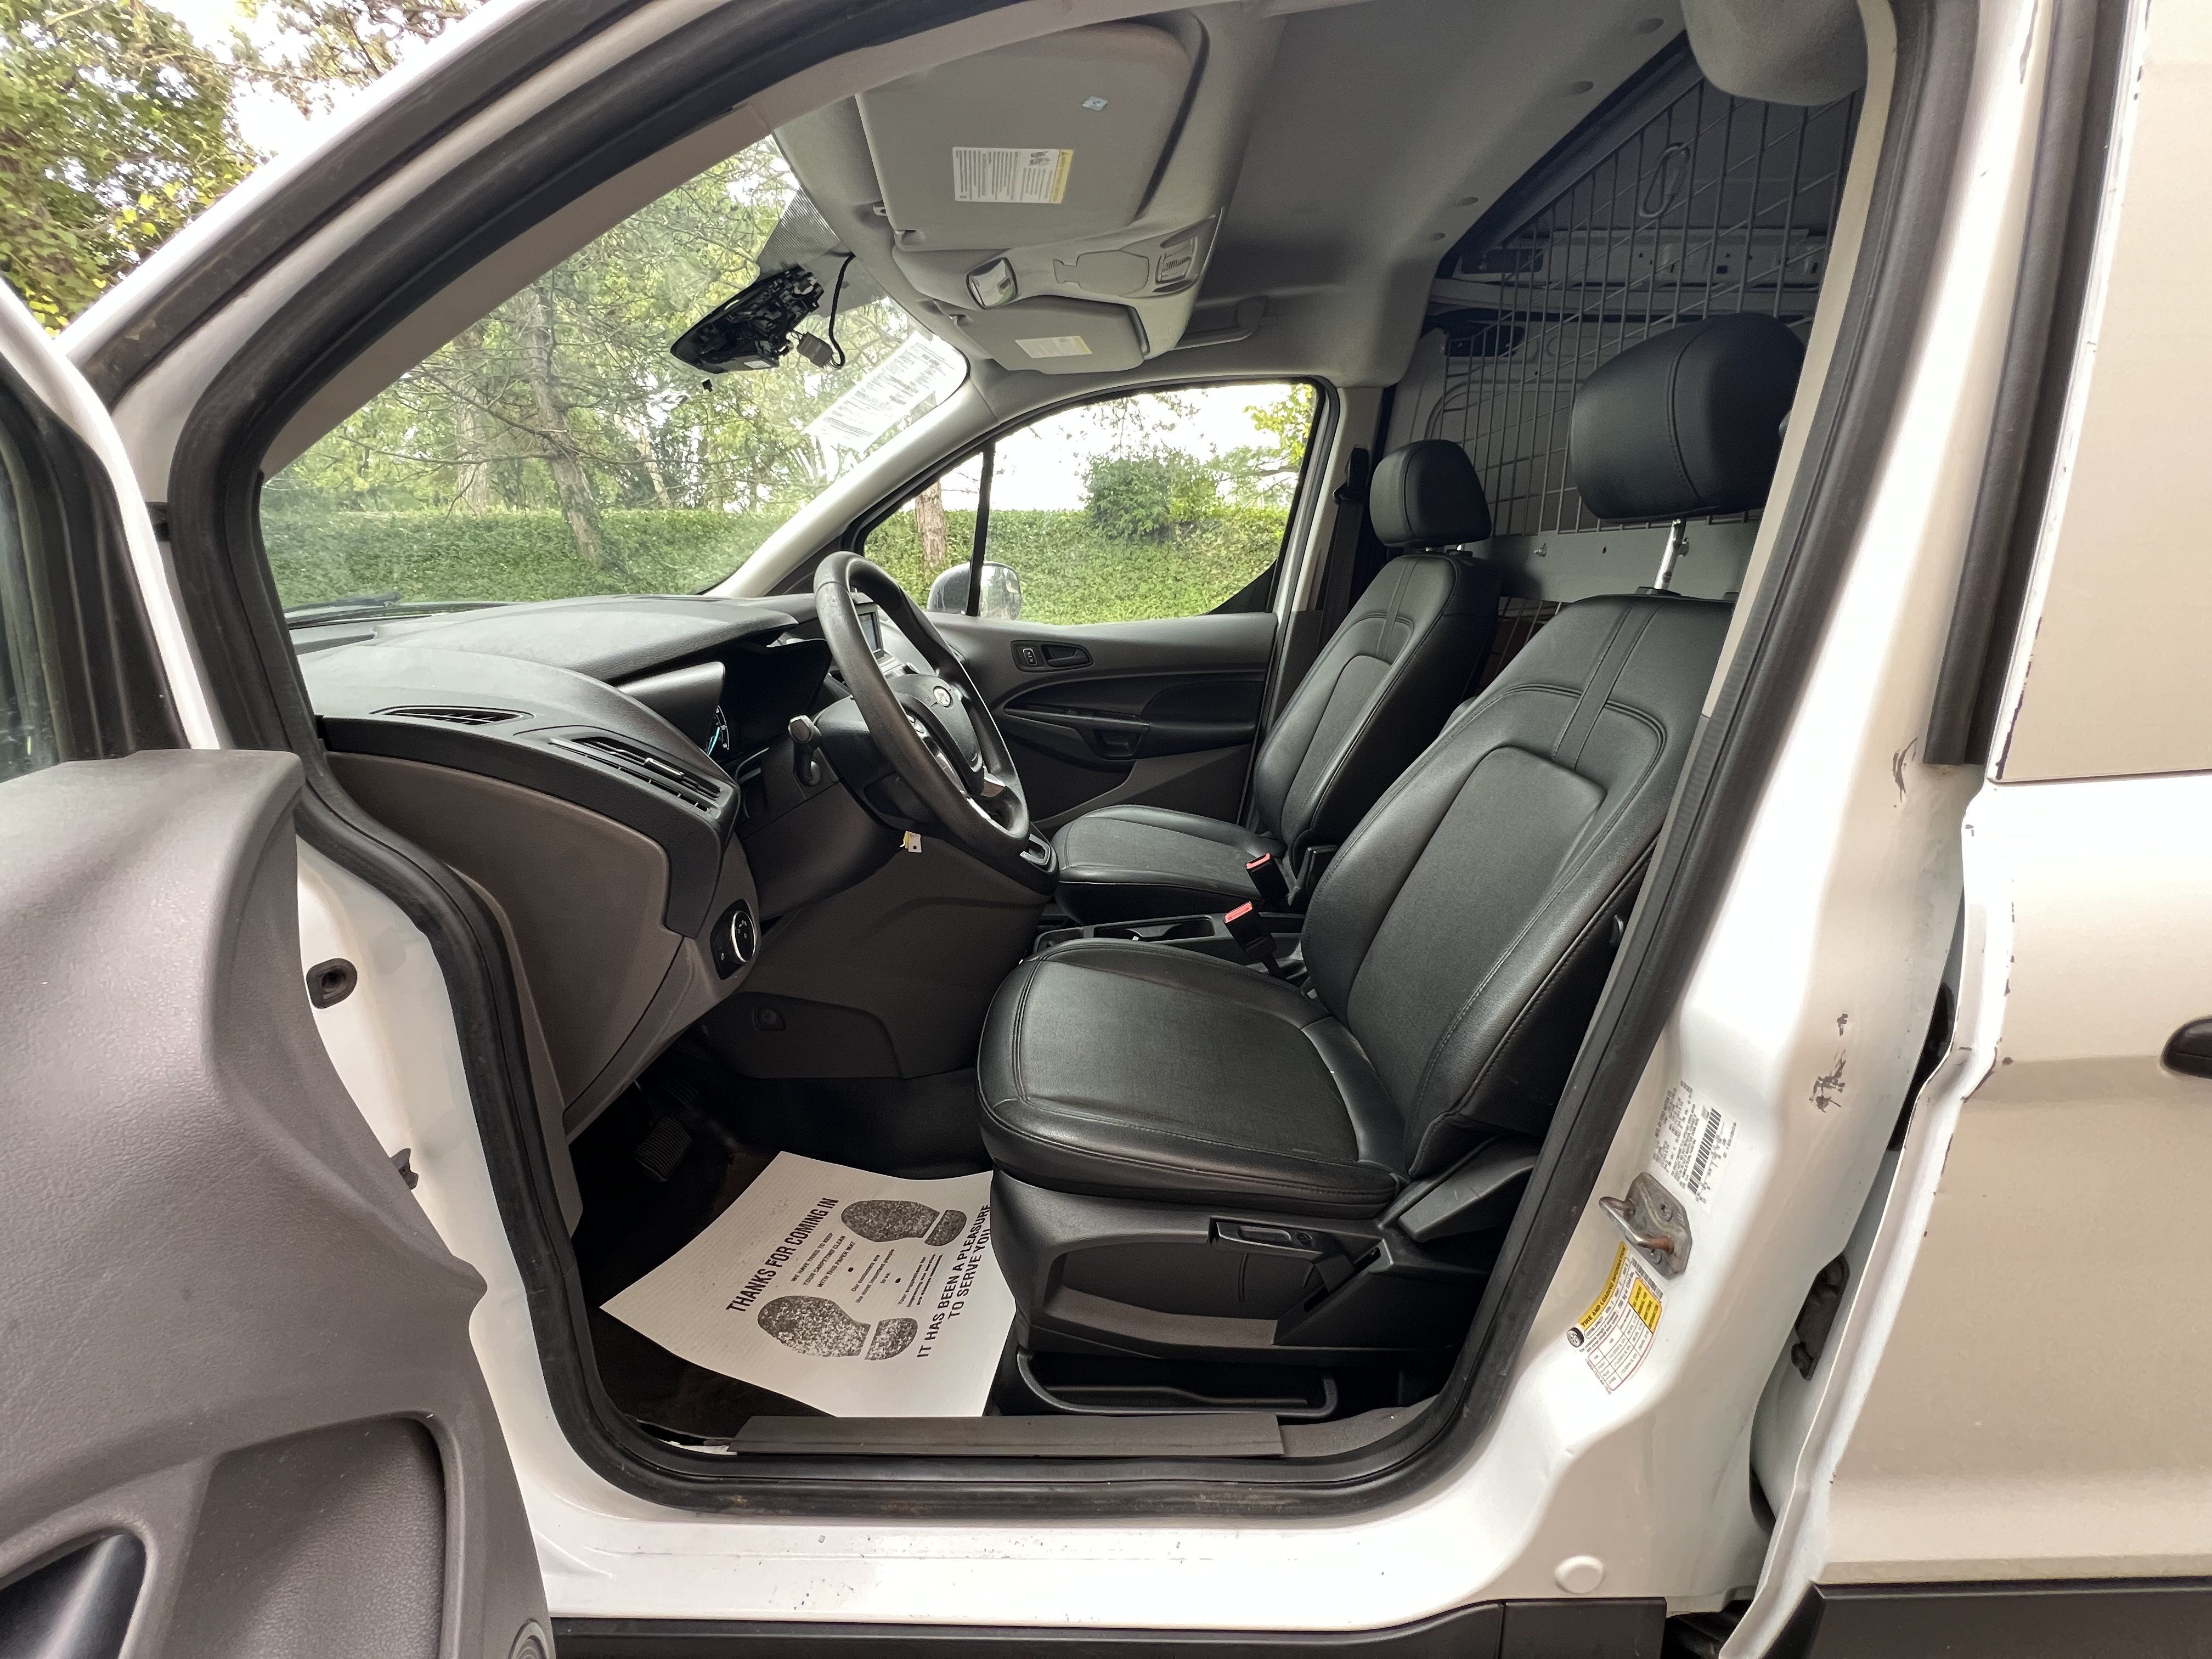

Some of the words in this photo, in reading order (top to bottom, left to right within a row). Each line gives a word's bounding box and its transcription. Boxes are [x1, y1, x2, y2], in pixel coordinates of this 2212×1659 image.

[725, 1268, 776, 1312] THANKS
[765, 1246, 797, 1267] FOR
[784, 1209, 829, 1245] COMING
[816, 1198, 839, 1209] IN
[797, 1262, 810, 1274] HAVE
[806, 1249, 820, 1262] TRIED
[822, 1232, 833, 1243] KEEP
[956, 1204, 991, 1261] PLEASURE
[802, 1272, 816, 1285] YOUR
[813, 1249, 835, 1273] CARPETING
[832, 1235, 846, 1250] CLEAN
[816, 1275, 830, 1288] WITH
[826, 1265, 838, 1275] THIS
[834, 1251, 849, 1265] PAPER
[845, 1241, 856, 1251] MAT
[952, 1262, 965, 1271] A
[937, 1275, 960, 1309] BEEN
[947, 1301, 964, 1320] TO
[957, 1255, 982, 1296] SERVE
[1581, 1314, 1593, 1328] TIRE
[1592, 1305, 1601, 1317] AND
[1599, 1282, 1614, 1306] LOADING
[924, 1312, 945, 1340] HAS
[917, 1345, 932, 1358] IT
